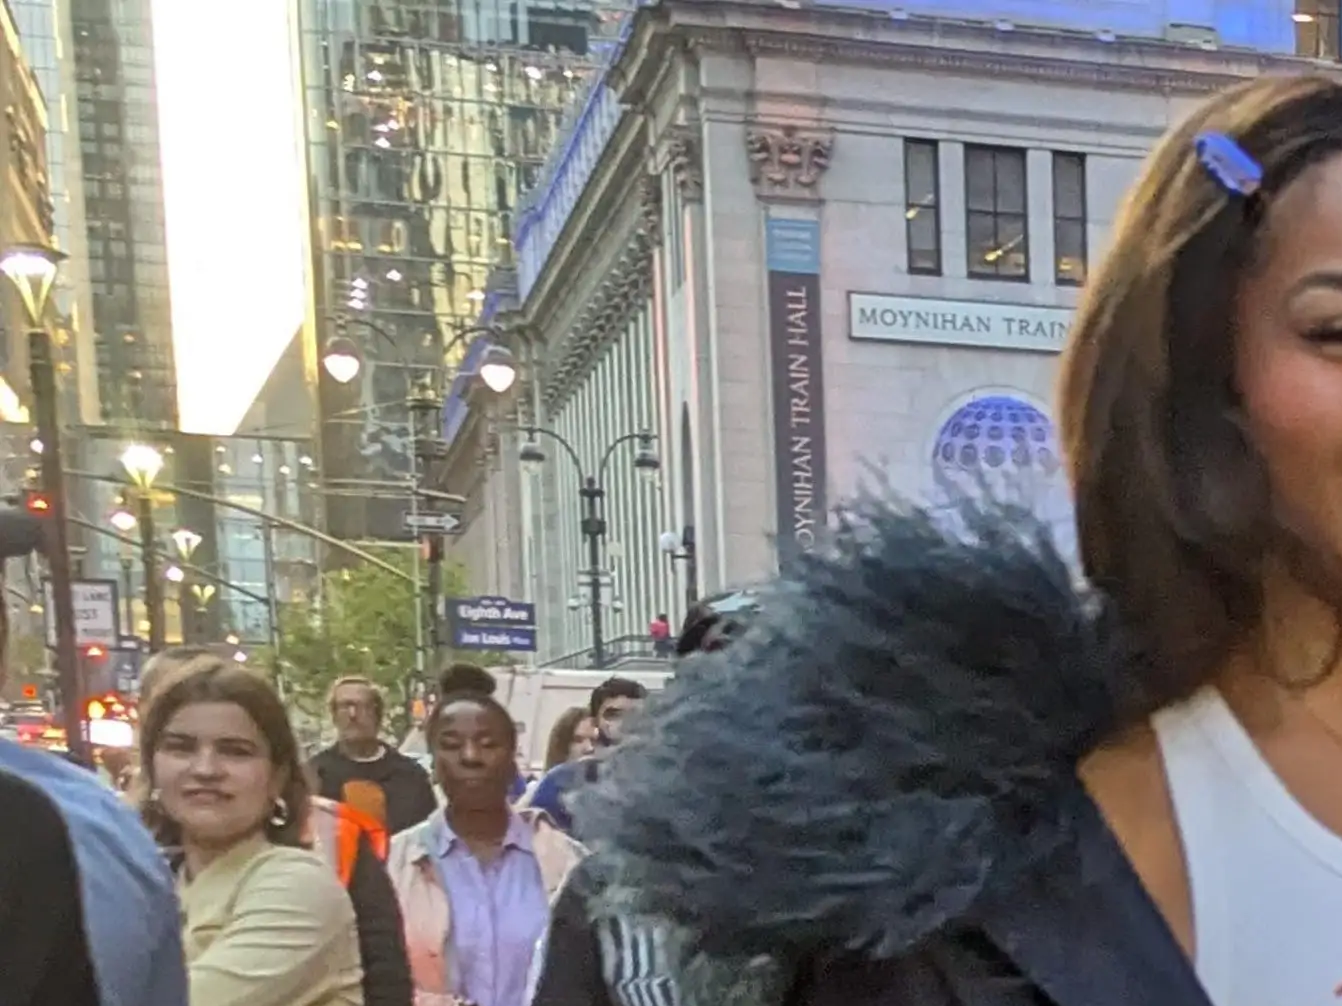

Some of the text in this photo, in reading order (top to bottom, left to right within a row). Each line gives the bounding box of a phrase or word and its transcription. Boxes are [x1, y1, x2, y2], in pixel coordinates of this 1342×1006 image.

[786, 286, 809, 345] HALL
[859, 307, 991, 332] MOYNIHAN
[789, 354, 811, 428] TRAIN
[791, 436, 816, 553] OYNIHAN
[503, 607, 529, 620] Ave
